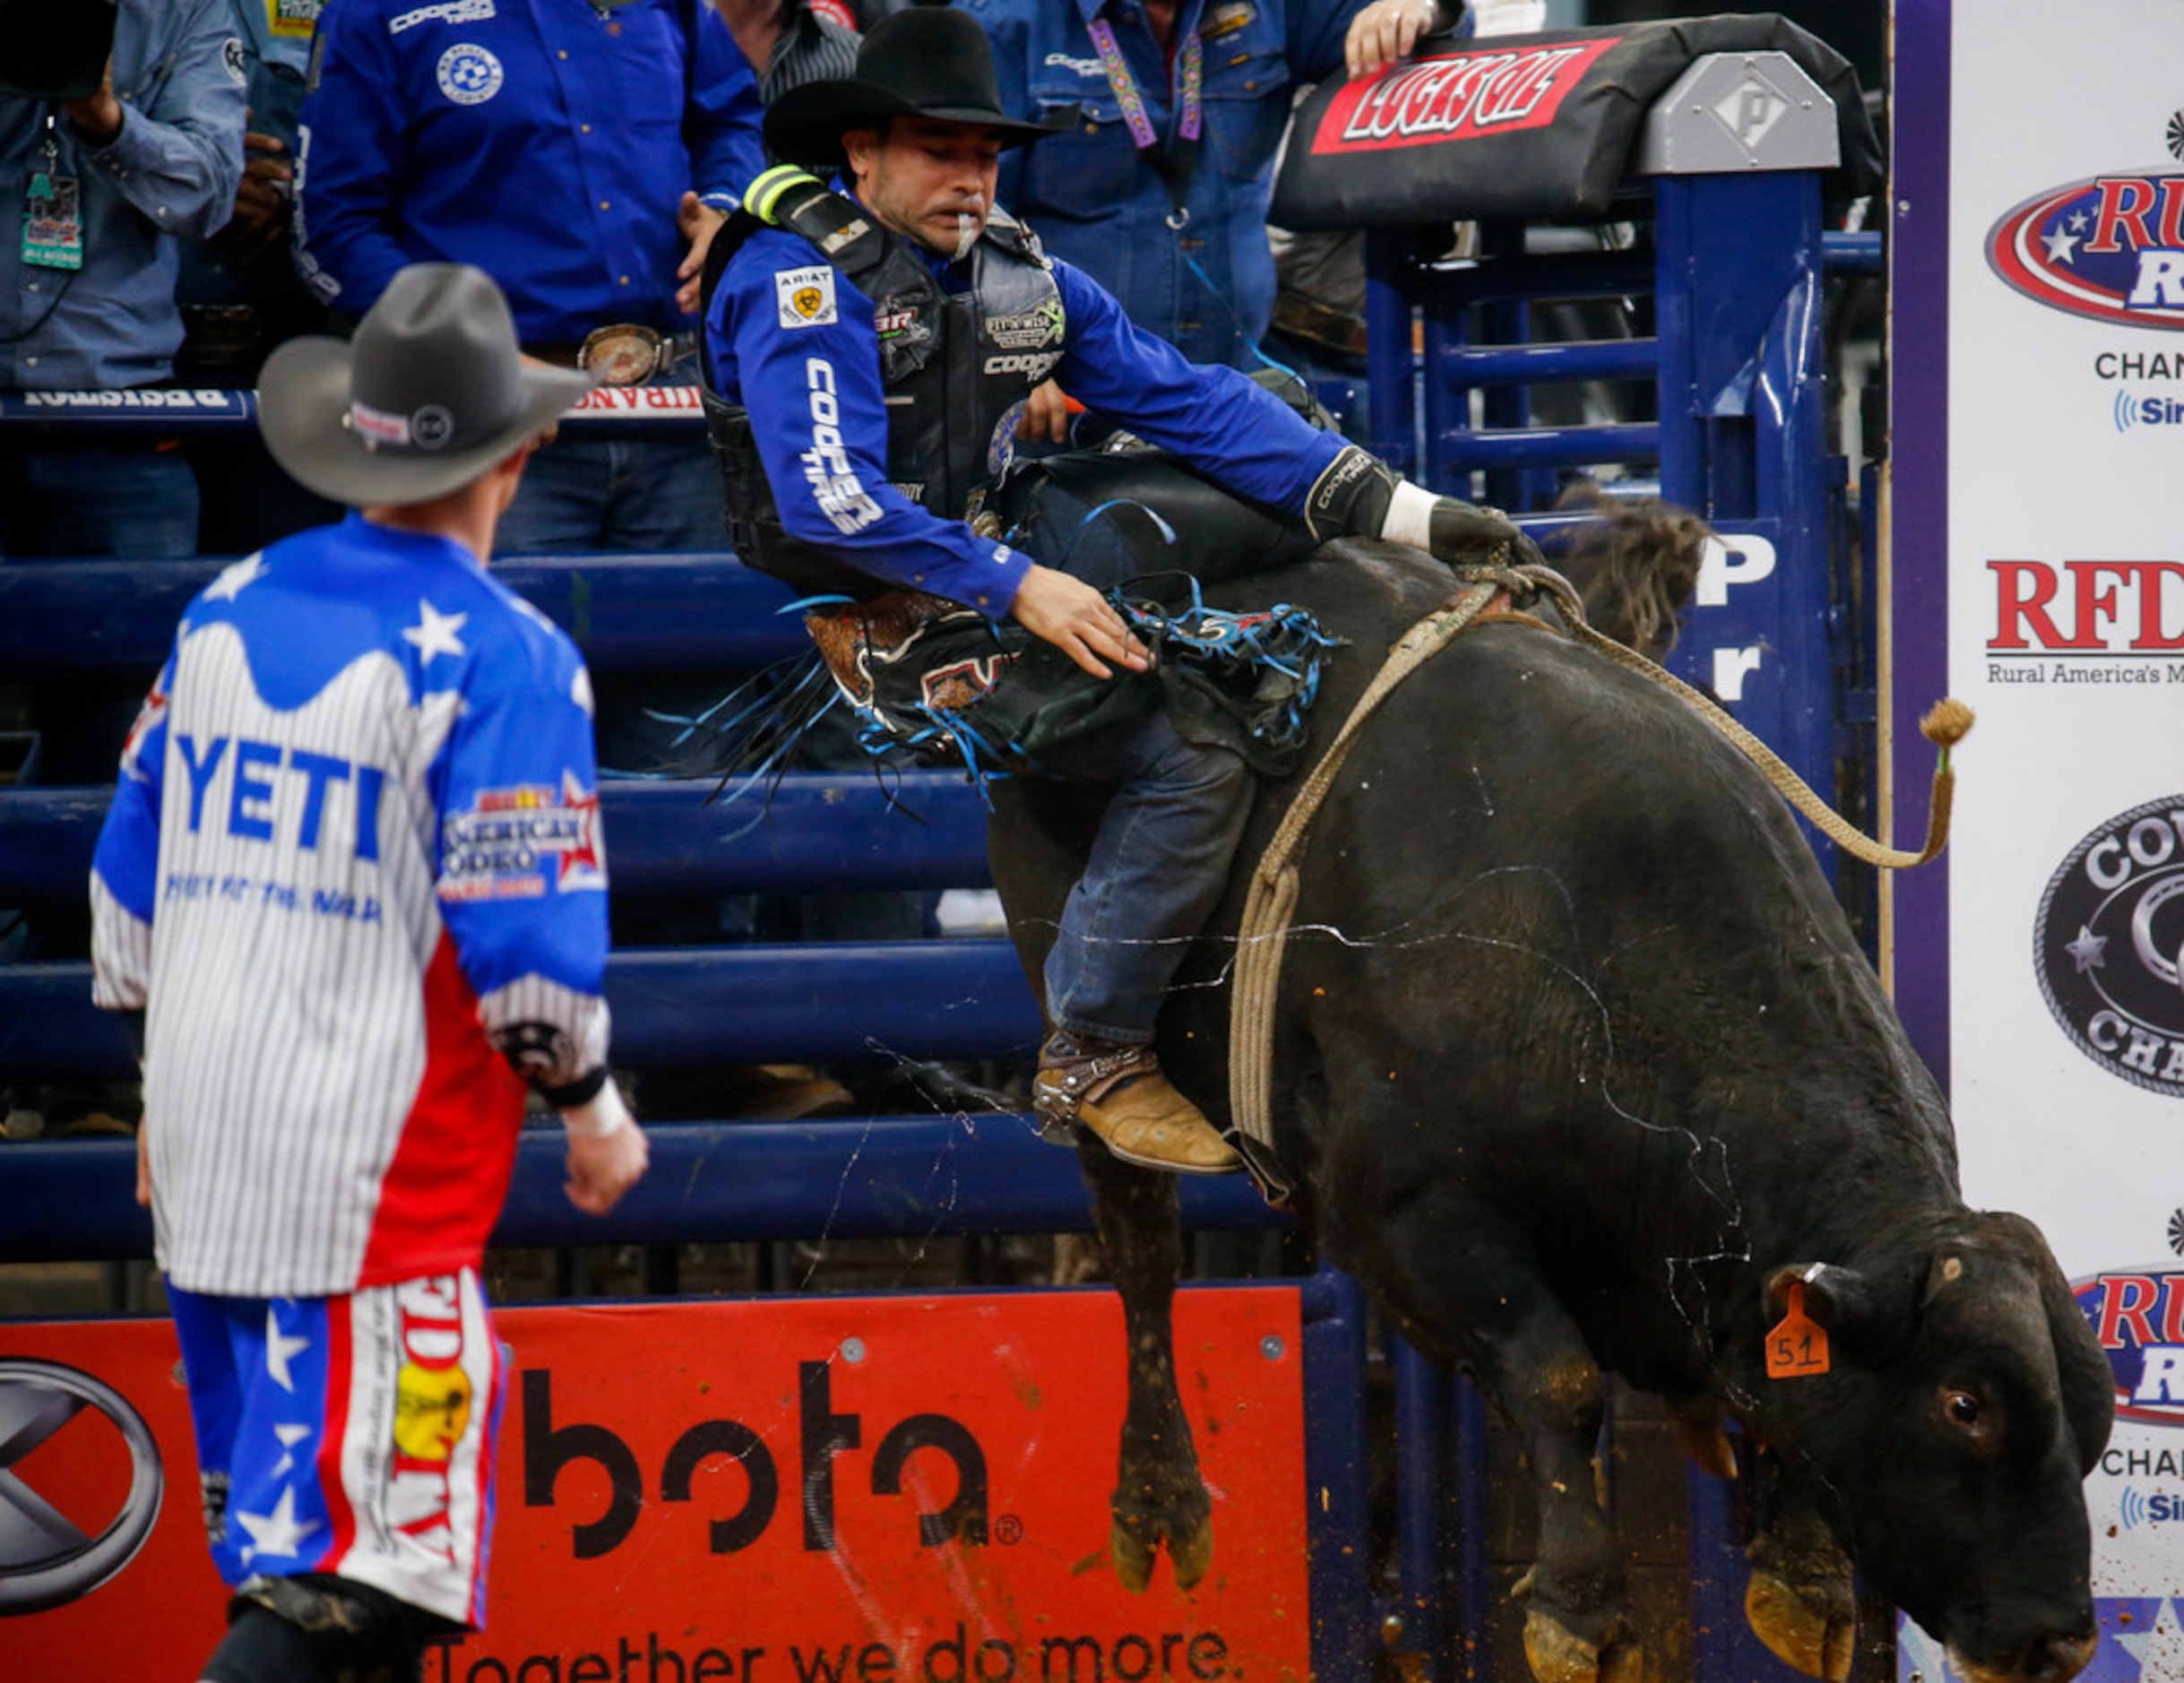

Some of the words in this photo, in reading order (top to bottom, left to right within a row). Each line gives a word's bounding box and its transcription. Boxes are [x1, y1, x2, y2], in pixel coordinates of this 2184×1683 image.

[781, 272, 830, 286] ARIAT
[807, 357, 885, 528] COOPER
[1988, 664, 2045, 683] Rural
[2052, 663, 2161, 683] America's
[175, 733, 388, 864] YETI
[1774, 1333, 1822, 1366] 51
[427, 1632, 764, 1683] Together
[789, 1639, 896, 1683] we
[923, 1621, 1018, 1683] do
[1040, 1630, 1245, 1683] more.
